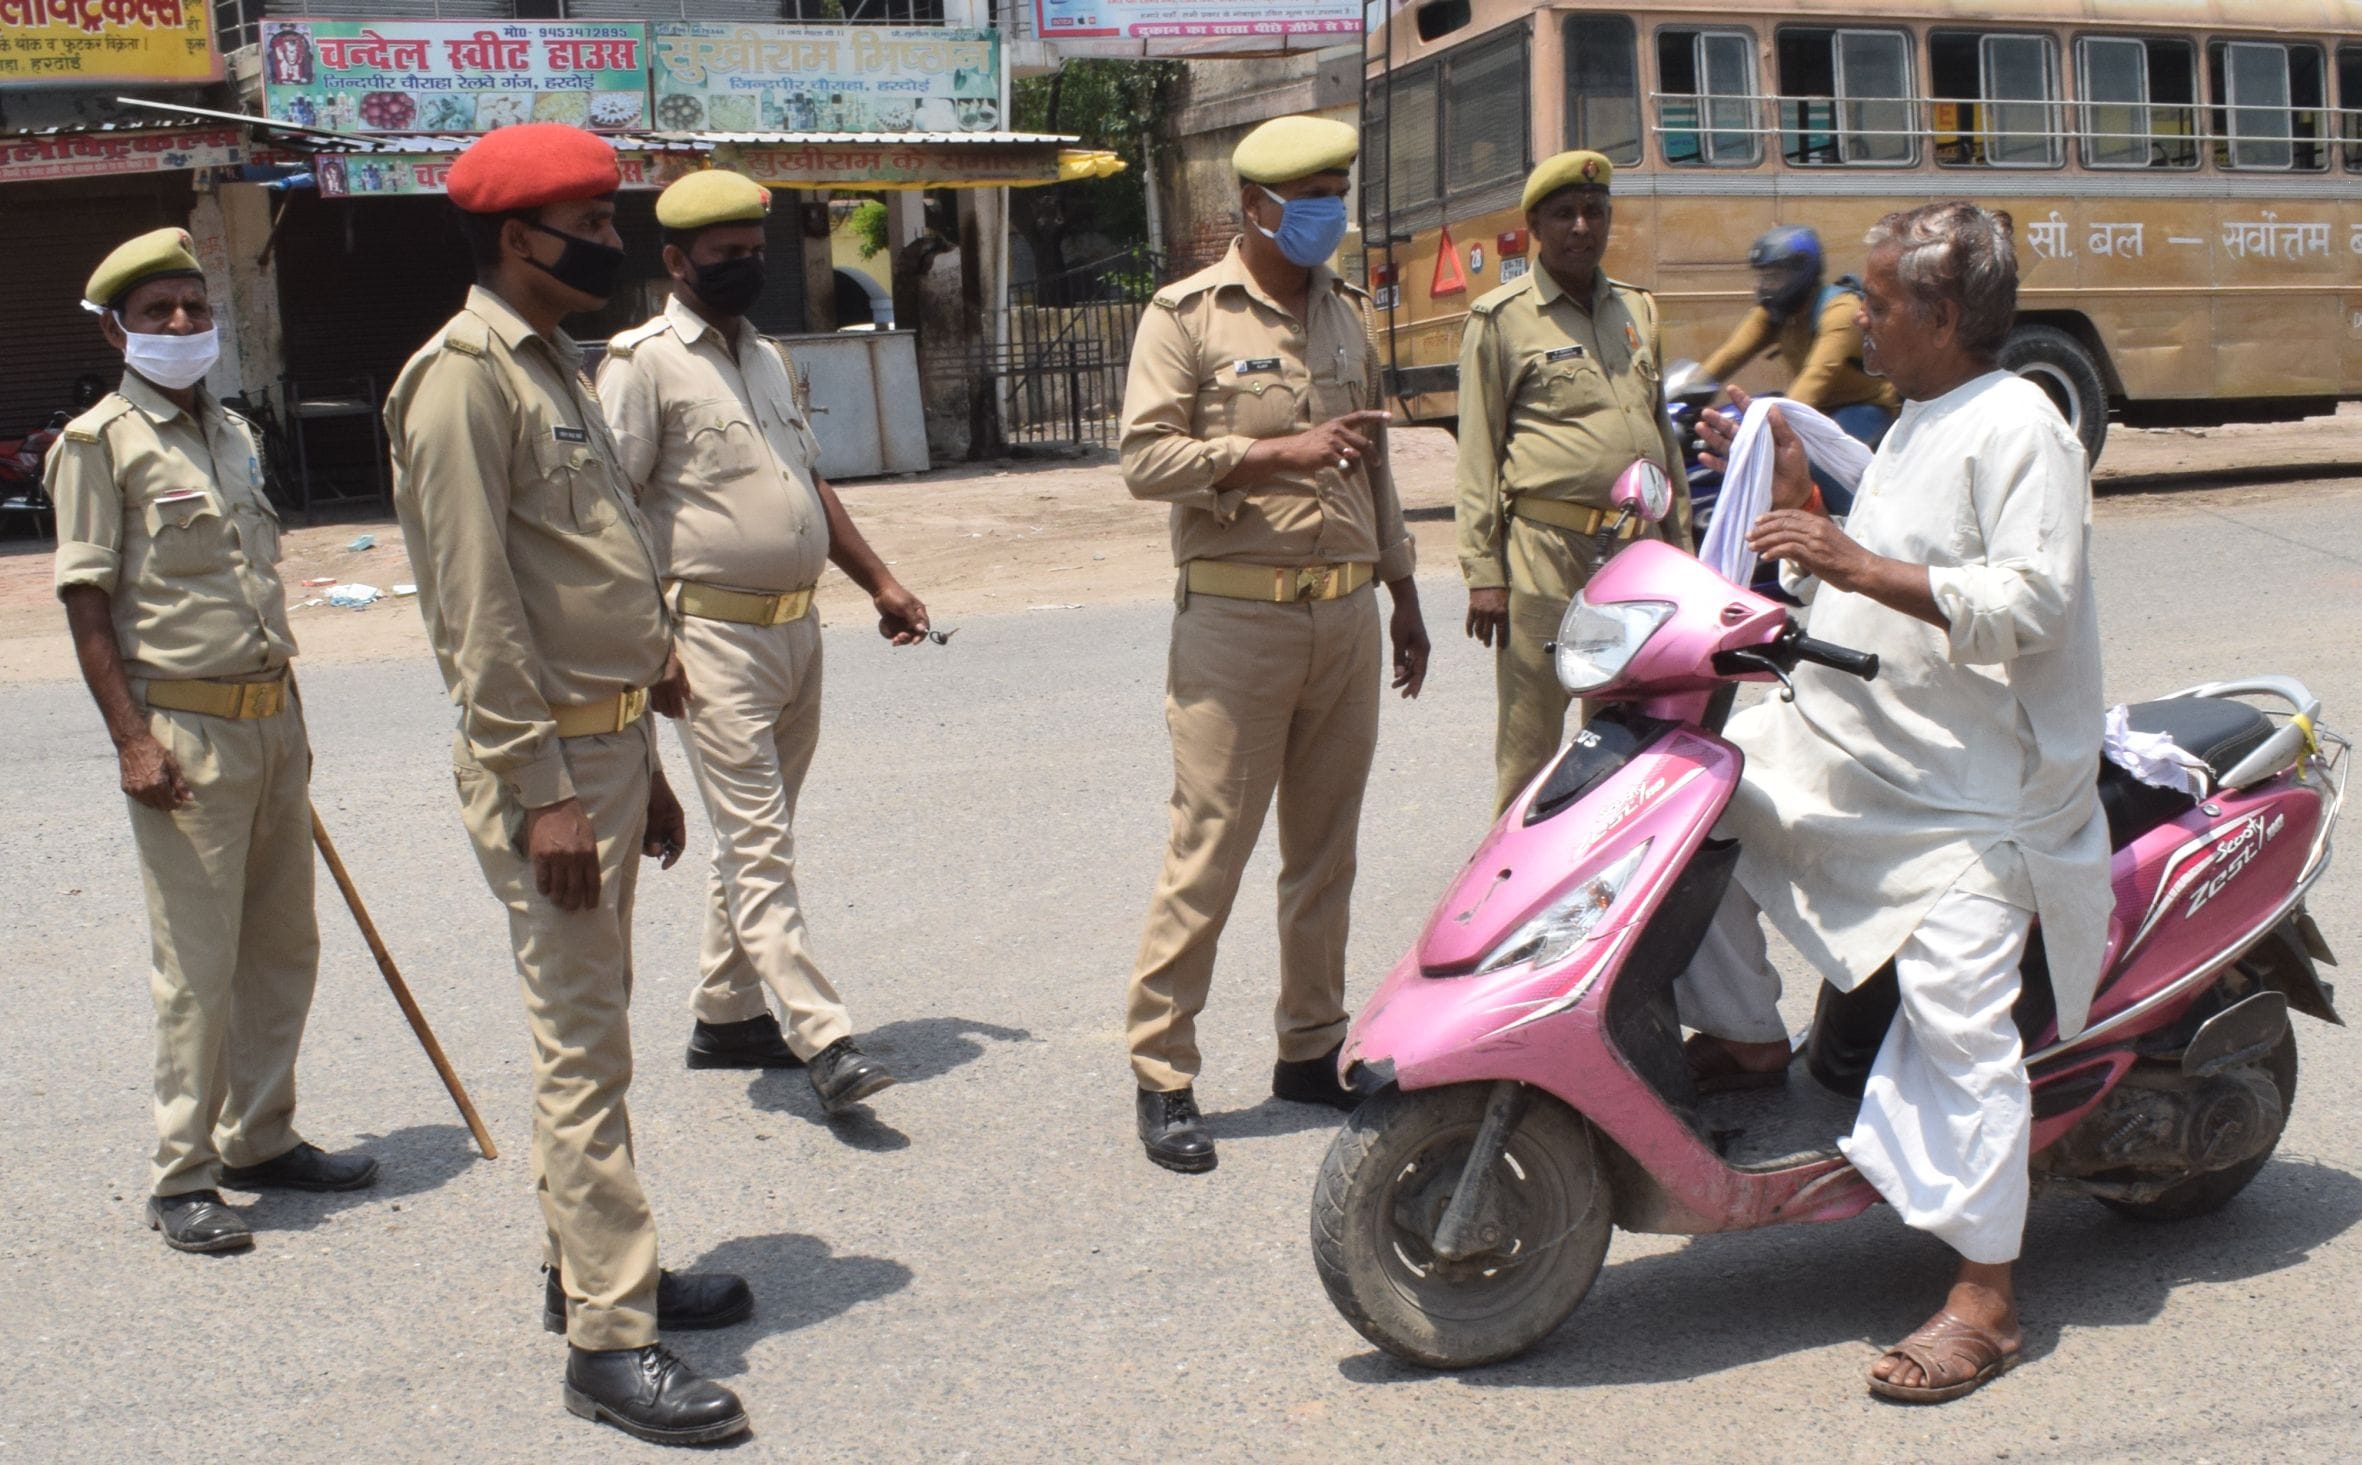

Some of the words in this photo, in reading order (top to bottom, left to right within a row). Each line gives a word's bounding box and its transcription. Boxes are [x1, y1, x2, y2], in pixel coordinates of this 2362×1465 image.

[539, 27, 628, 38] 9453472895
[30, 52, 82, 73] हरदोई
[316, 29, 431, 71] चन्देल
[443, 29, 532, 72] स्वीट
[543, 39, 638, 71] हाउस
[657, 28, 840, 85] सुखीराम
[323, 73, 395, 90] जिन्दपीर
[401, 73, 452, 90] चौराहा
[457, 73, 496, 90] रेलवे
[545, 73, 595, 90] हरदोई
[876, 77, 931, 93] हरदोई
[744, 147, 883, 177] सुखीराम
[2027, 209, 2074, 259] सी.
[2088, 221, 2144, 260] बल
[2221, 209, 2332, 261] सर्वोत्तम
[1471, 248, 1482, 268] 28
[1573, 729, 1602, 748] VS
[2215, 814, 2265, 863] Scooty
[2184, 842, 2258, 919] Zest
